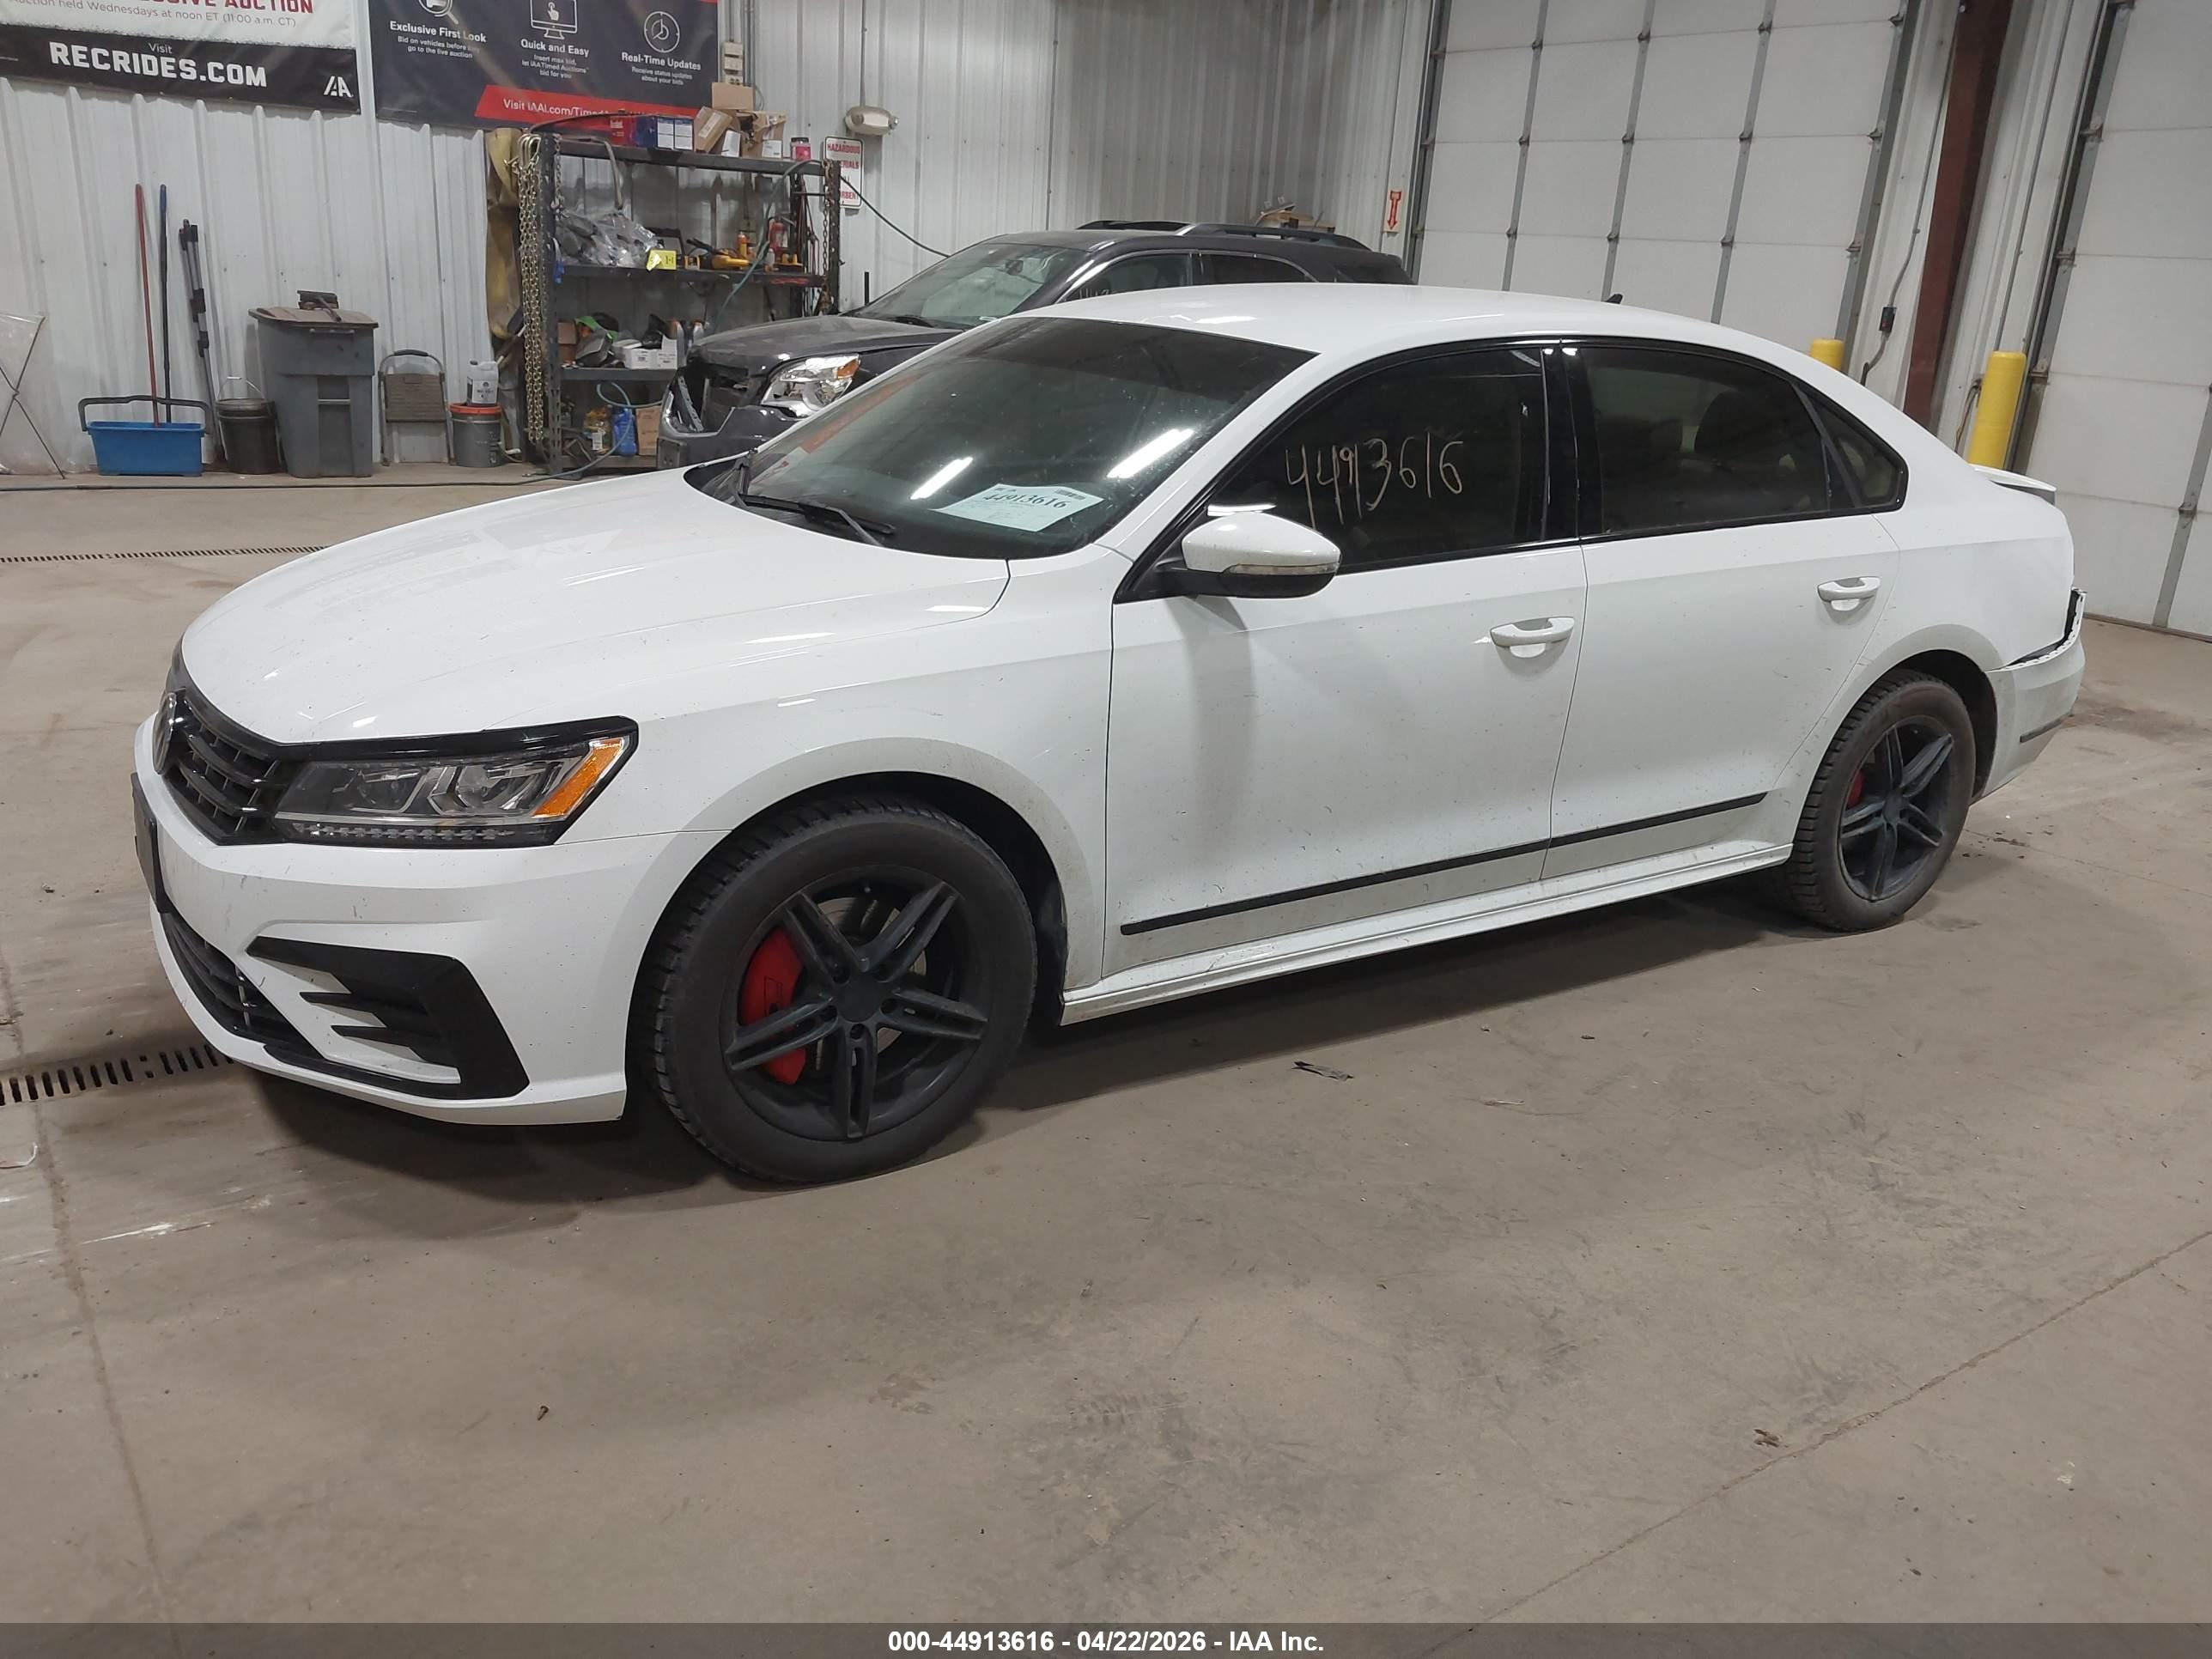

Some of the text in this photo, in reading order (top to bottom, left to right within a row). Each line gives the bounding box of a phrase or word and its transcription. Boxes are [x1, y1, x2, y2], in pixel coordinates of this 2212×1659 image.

[88, 2, 158, 17] Wednesdays
[161, 9, 173, 18] at
[176, 11, 203, 21] noon
[206, 12, 220, 21] ET
[278, 17, 296, 27] CT)
[390, 21, 487, 43] Exclusive First Look
[148, 42, 173, 54] Visit
[420, 40, 446, 48] vehicles
[520, 39, 590, 58] Quick and Easy
[49, 41, 267, 88] RECRIDES.COM
[621, 52, 702, 70] Real-Time Updates
[503, 98, 526, 111] Visit
[1285, 432, 1463, 530] 44913616
[983, 494, 1070, 508] 44913616
